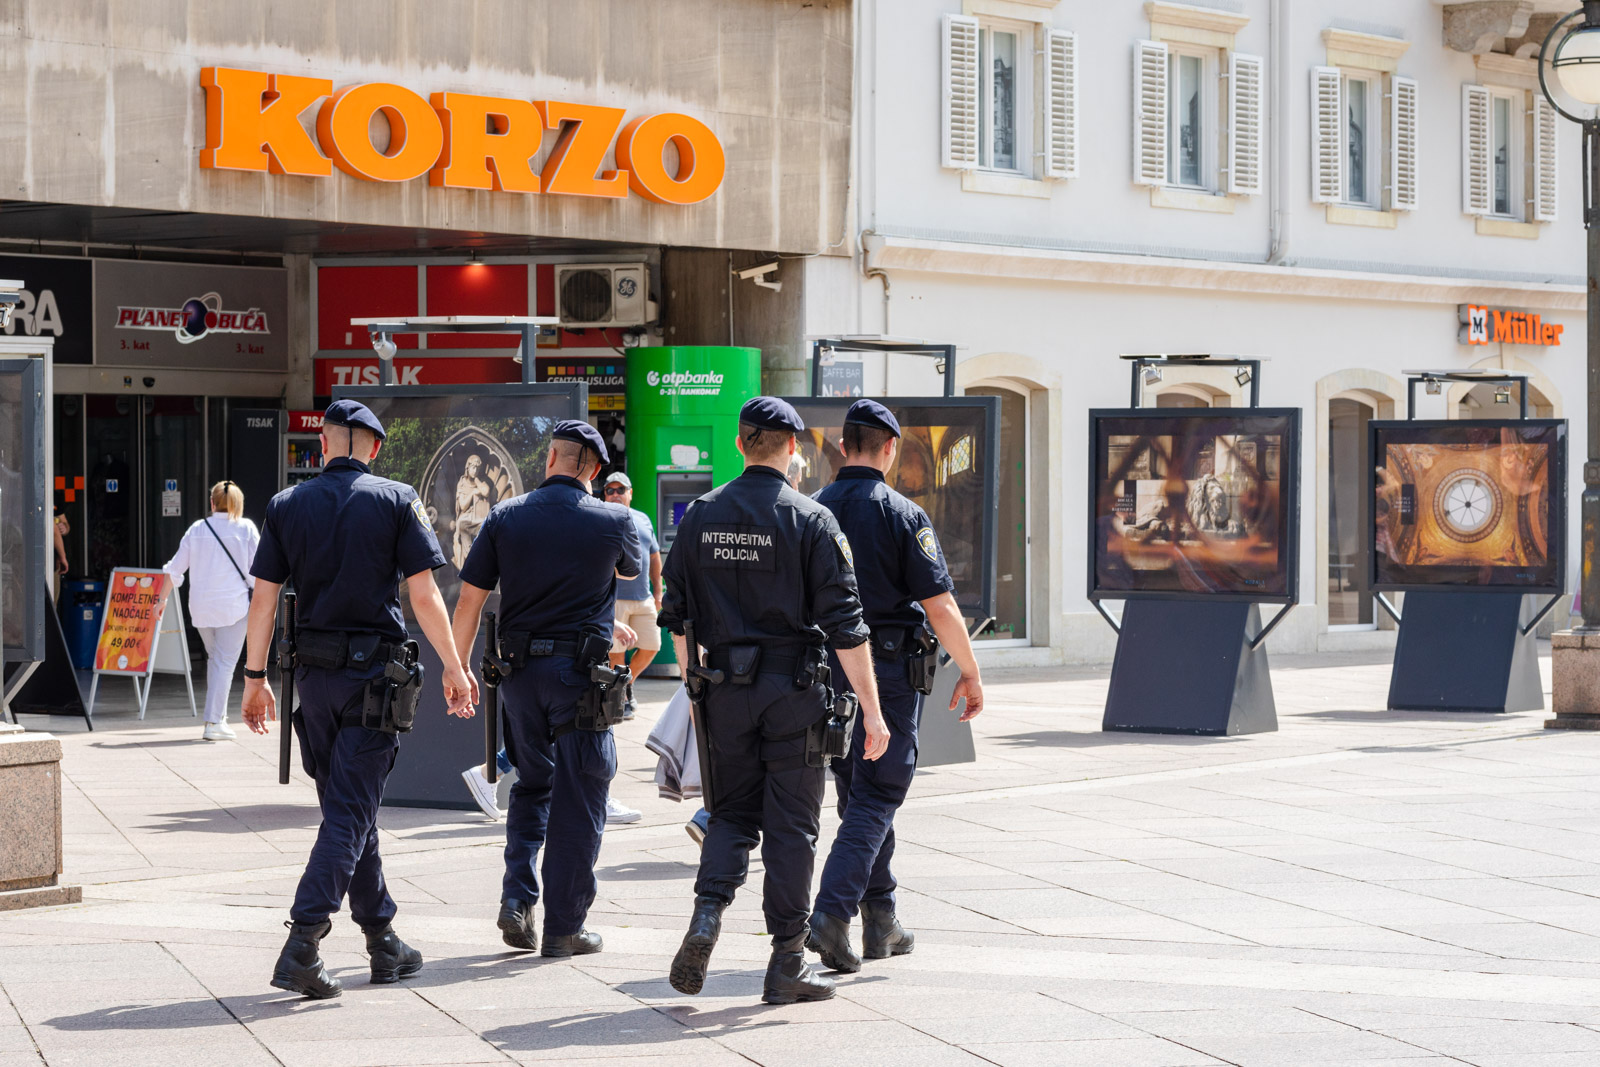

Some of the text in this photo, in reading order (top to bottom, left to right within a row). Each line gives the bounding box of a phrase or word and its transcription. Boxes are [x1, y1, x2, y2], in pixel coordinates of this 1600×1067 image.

[200, 67, 725, 204] KORZO
[118, 308, 266, 331] PLANET OBUĆA
[1492, 310, 1564, 346] Müller
[120, 340, 150, 351] 3. kat
[236, 343, 264, 354] 3. kat
[662, 370, 724, 387] otpbanka
[823, 367, 861, 378] CAFFE BAR
[586, 376, 624, 385] USLUGA
[247, 417, 273, 427] TISAK
[702, 532, 772, 547] INTERVENTNA
[714, 548, 759, 561] POLICIJA
[111, 592, 160, 605] KOMPLETNE
[112, 606, 151, 619] NAOČALE
